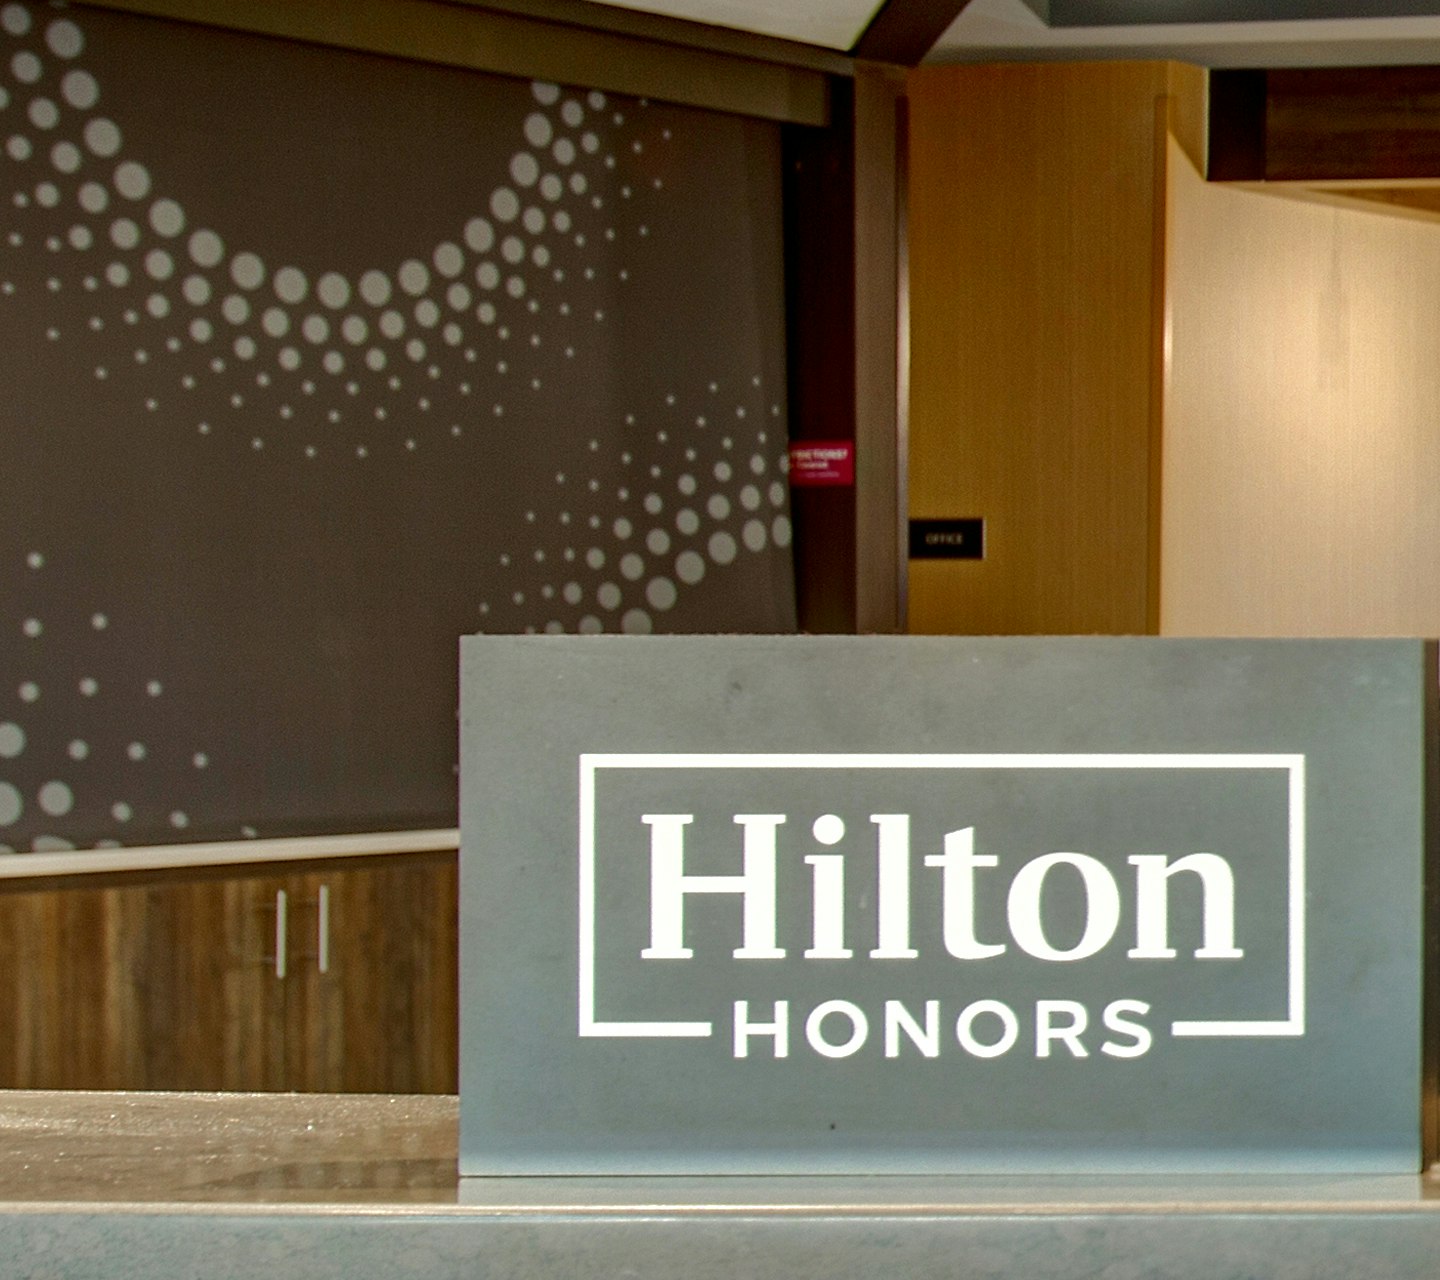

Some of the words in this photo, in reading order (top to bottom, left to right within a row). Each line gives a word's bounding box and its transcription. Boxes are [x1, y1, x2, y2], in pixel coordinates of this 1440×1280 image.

[925, 532, 964, 545] OFFICE
[641, 814, 1243, 961] Hilton
[735, 1000, 1152, 1058] HONORS
